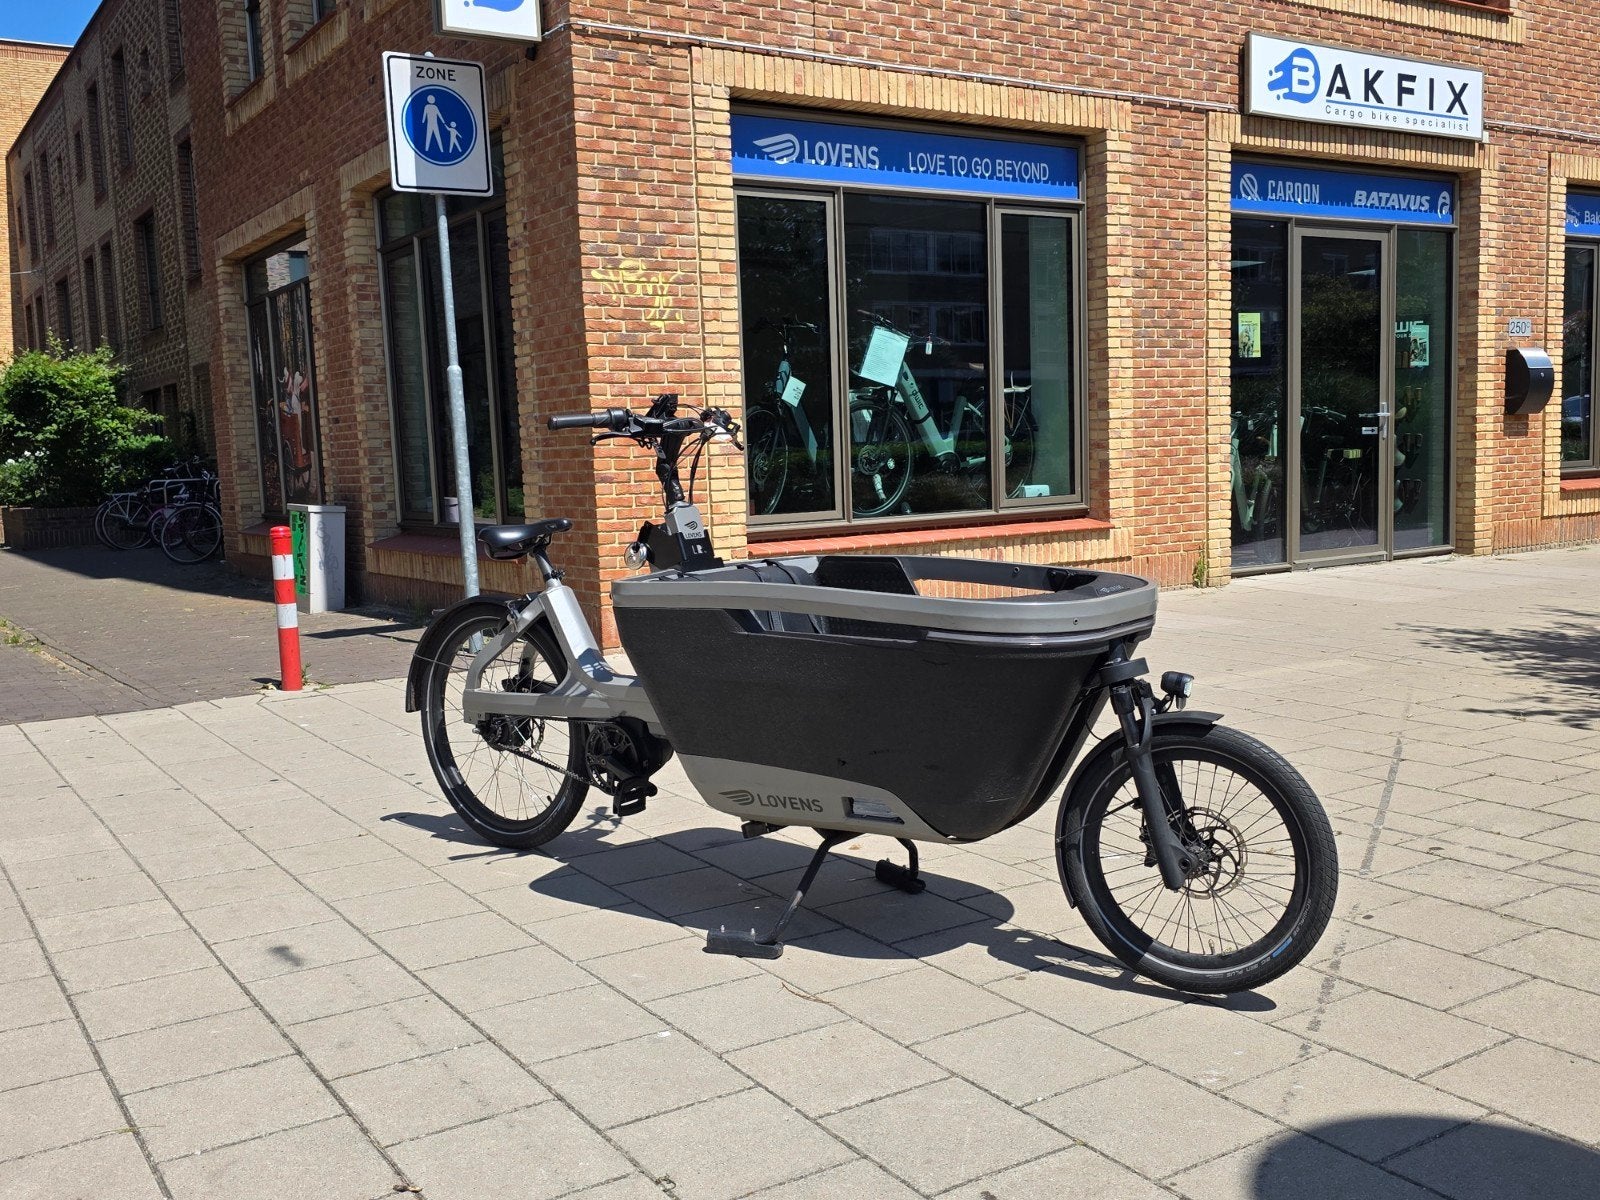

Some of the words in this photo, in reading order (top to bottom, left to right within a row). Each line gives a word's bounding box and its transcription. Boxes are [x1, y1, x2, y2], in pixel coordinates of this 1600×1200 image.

[415, 66, 457, 82] ZONE
[1292, 57, 1469, 116] BAKFIX
[1325, 104, 1363, 119] Cargo
[1371, 111, 1398, 123] bike
[1405, 117, 1469, 132] specialist
[803, 140, 880, 170] LOVENS
[909, 151, 945, 175] LOVE
[950, 156, 968, 178] TO
[972, 157, 992, 178] GO
[996, 160, 1050, 182] BEYOND
[1267, 179, 1320, 205] CARQON
[1353, 190, 1431, 211] BATAVUS
[757, 793, 824, 813] LOVENS
